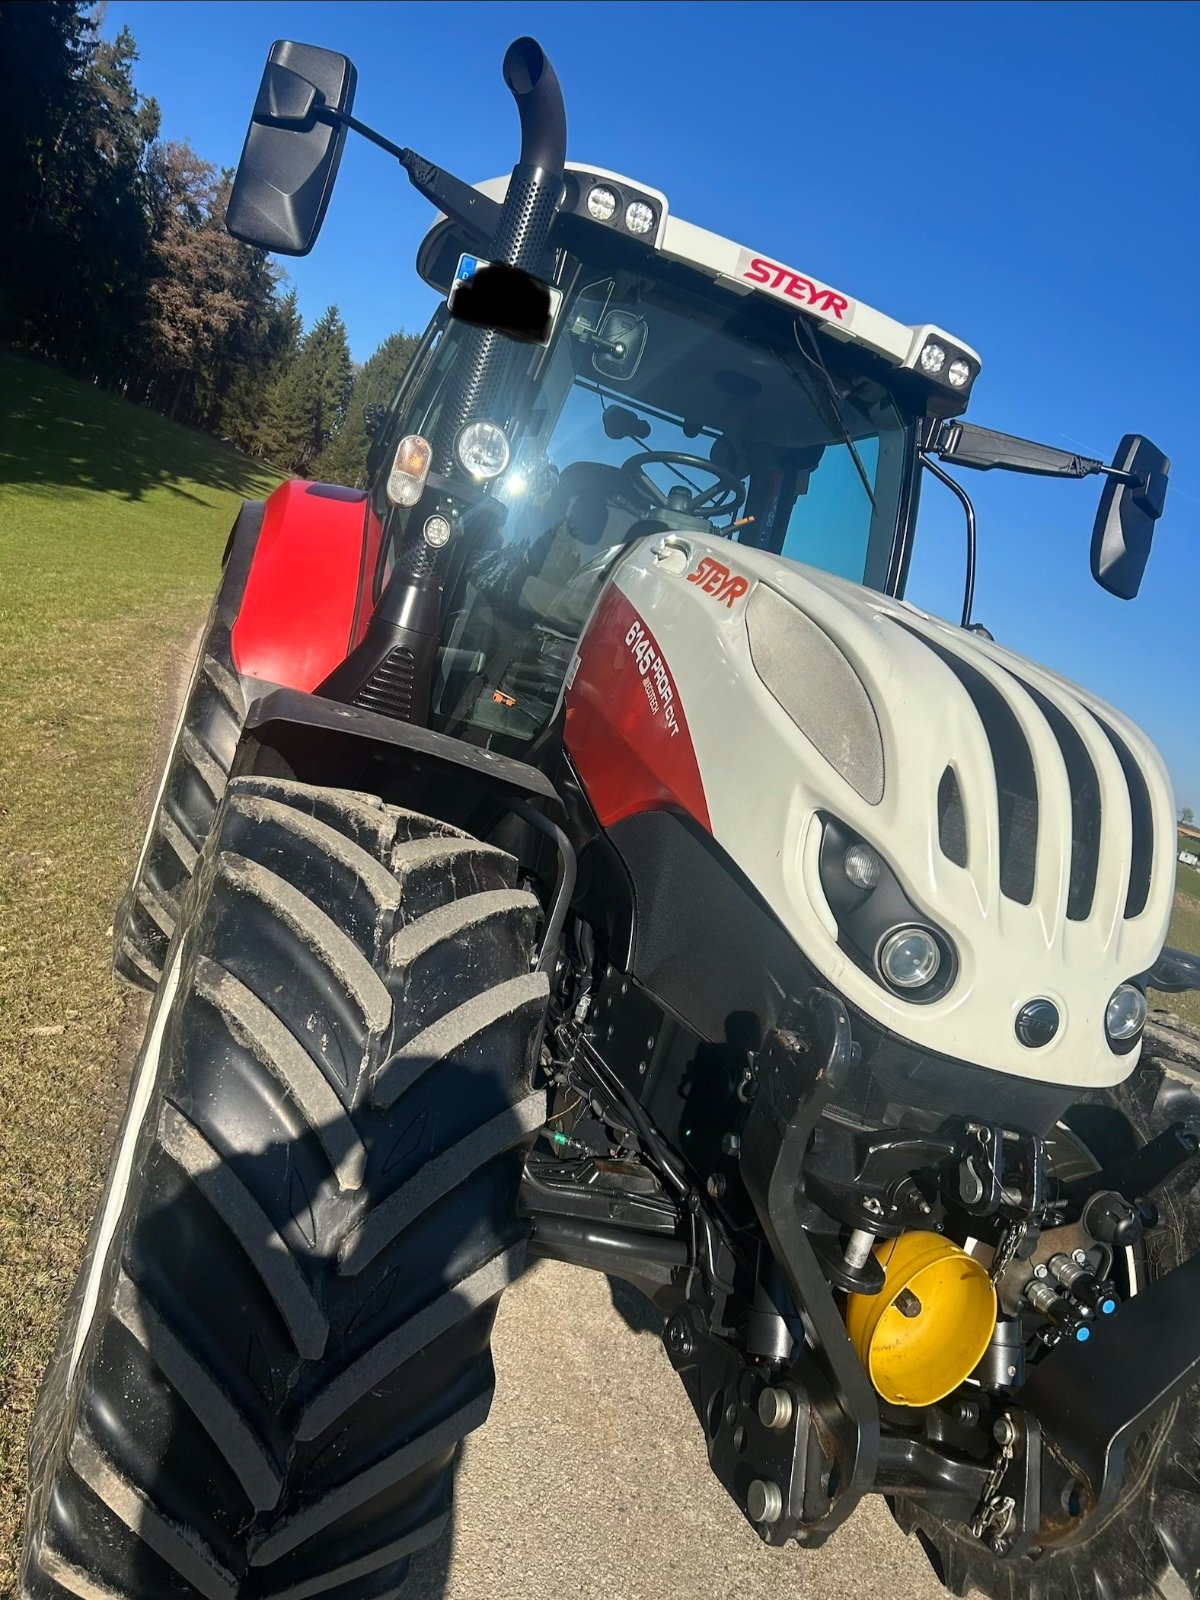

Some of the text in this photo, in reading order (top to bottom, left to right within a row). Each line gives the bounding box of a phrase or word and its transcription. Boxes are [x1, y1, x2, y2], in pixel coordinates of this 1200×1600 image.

[743, 258, 848, 320] STEYR
[686, 556, 749, 608] STEYR
[625, 620, 679, 737] 6145 PROFI CVT
